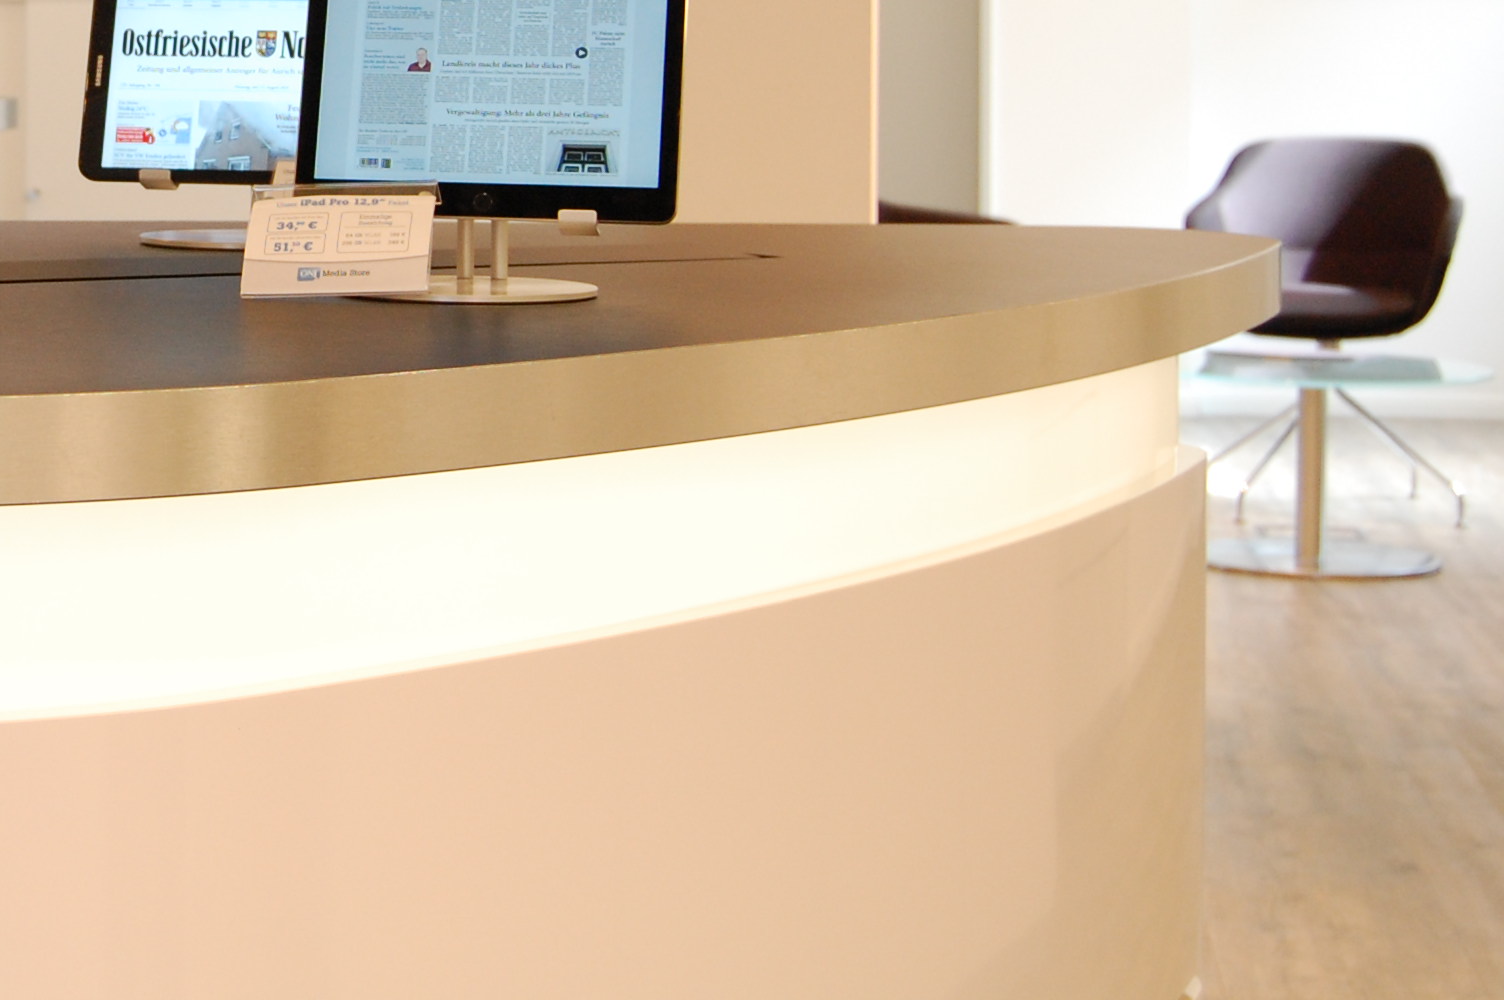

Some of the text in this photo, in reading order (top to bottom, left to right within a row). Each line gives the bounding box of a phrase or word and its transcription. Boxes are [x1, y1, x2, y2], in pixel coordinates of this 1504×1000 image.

[121, 28, 252, 58] Ostfriesische
[300, 198, 326, 206] iPad
[330, 198, 349, 206] Pro
[322, 269, 347, 277] Media
[349, 269, 370, 277] Store
